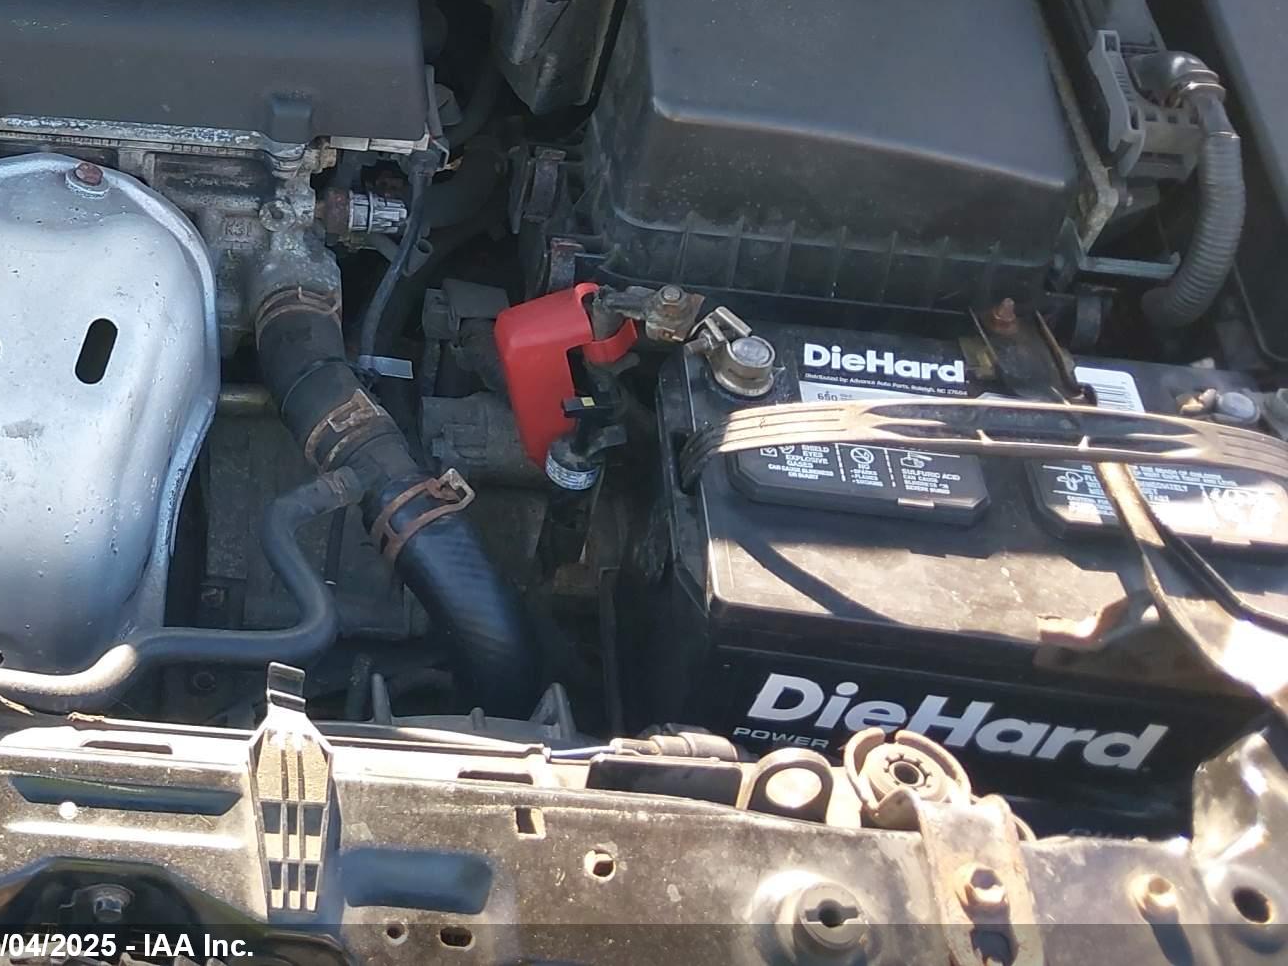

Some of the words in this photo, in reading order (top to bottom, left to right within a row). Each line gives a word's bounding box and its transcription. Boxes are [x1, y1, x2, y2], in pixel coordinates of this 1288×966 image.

[803, 342, 966, 383] DieHard
[849, 377, 876, 386] Advance
[732, 726, 831, 749] POWER
[746, 672, 1170, 771] DieHard
